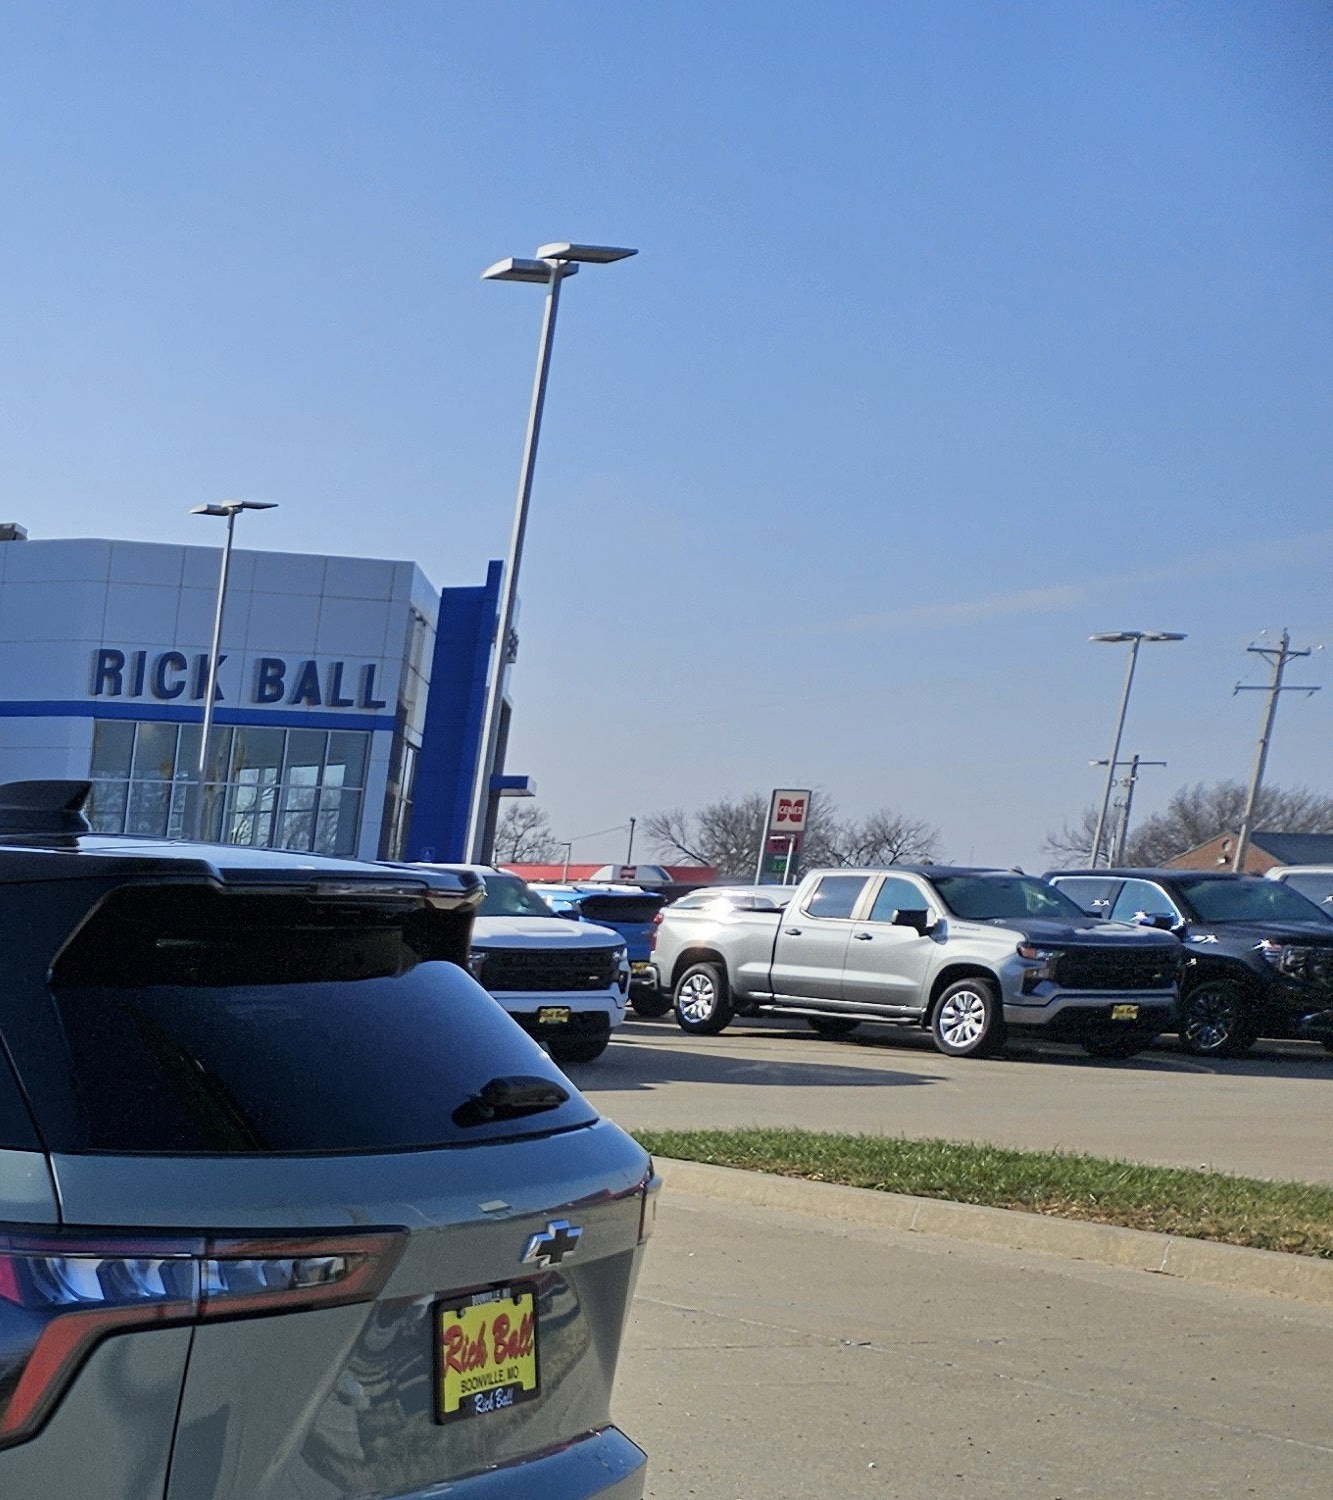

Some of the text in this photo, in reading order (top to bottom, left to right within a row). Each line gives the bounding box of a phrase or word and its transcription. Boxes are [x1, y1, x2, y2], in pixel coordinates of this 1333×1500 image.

[90, 648, 387, 708] RICK BALL
[443, 1311, 534, 1378] Rick Ball
[507, 1365, 520, 1379] MO
[495, 1387, 513, 1408] Ball
